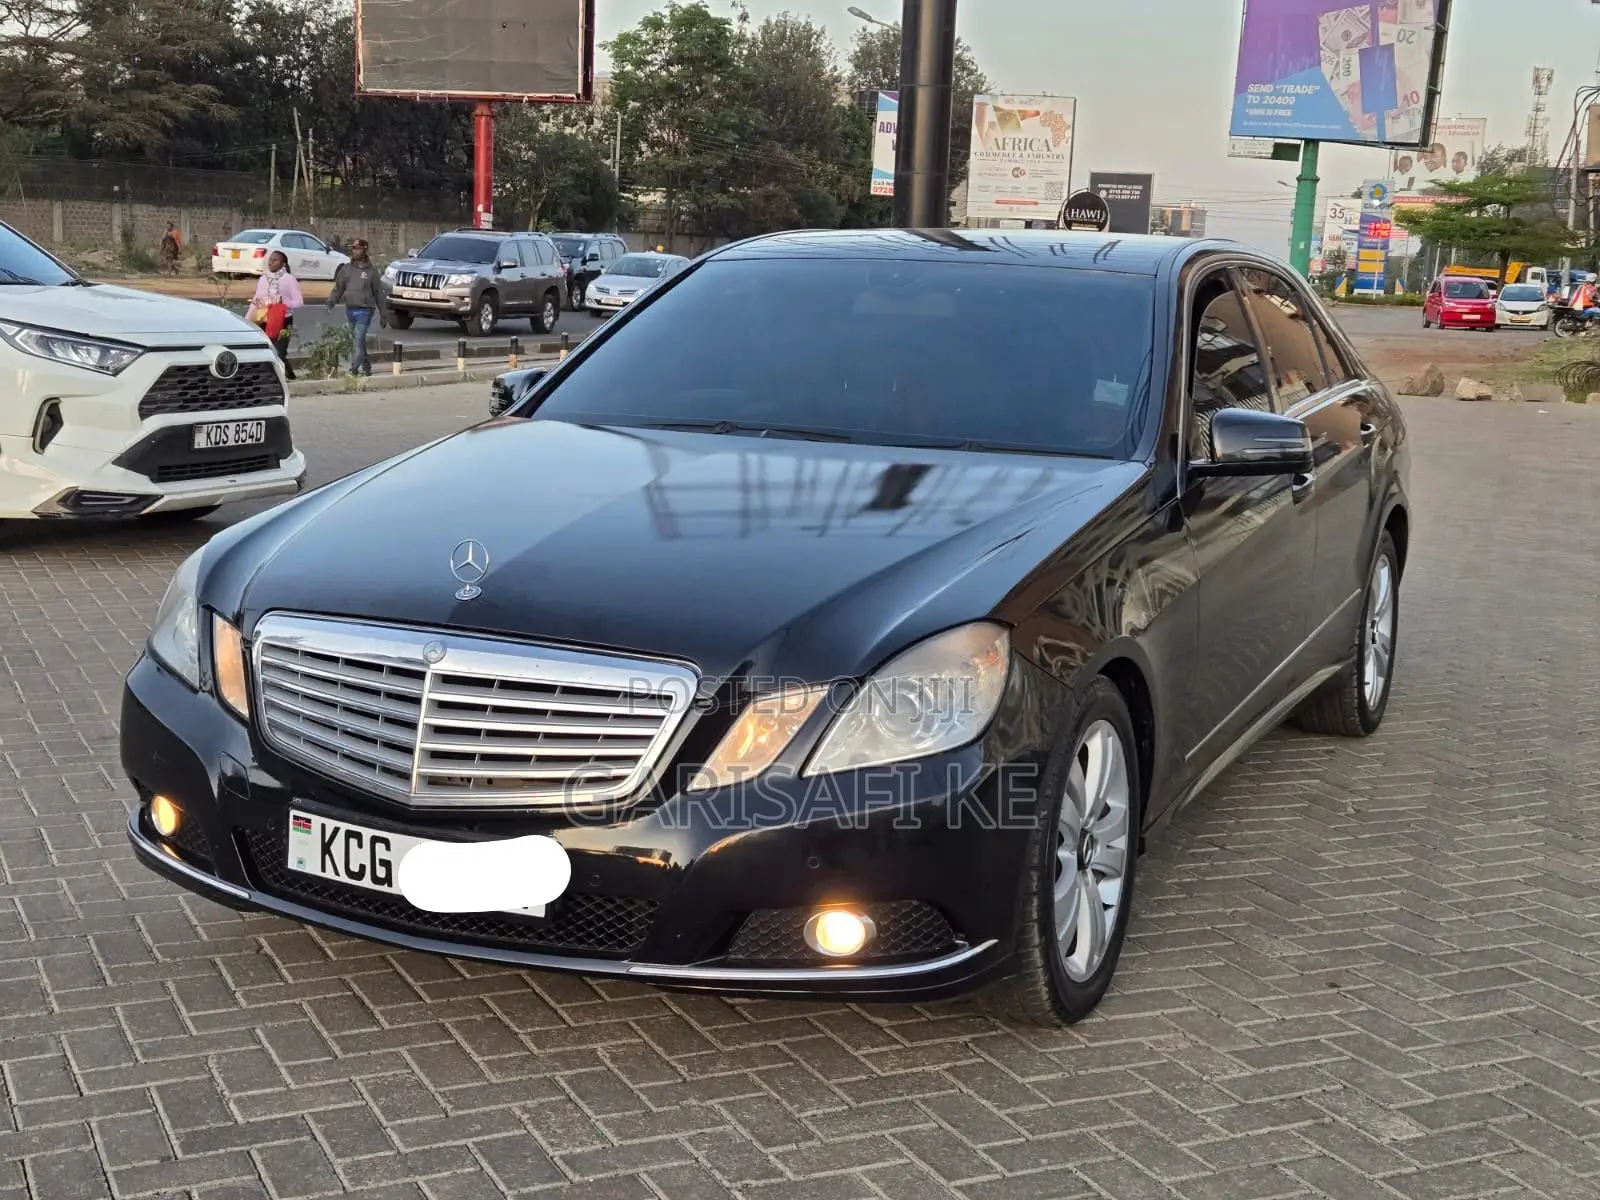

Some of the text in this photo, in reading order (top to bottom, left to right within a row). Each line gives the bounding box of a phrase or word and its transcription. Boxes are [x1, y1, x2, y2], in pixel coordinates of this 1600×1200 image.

[1247, 84, 1273, 93] SEND
[1246, 95, 1260, 104] TO
[989, 136, 1052, 152] AFRICA
[1071, 208, 1100, 219] HAWI
[1329, 207, 1345, 219] 35
[206, 422, 262, 446] KDS 854D
[320, 822, 393, 888] KCG
